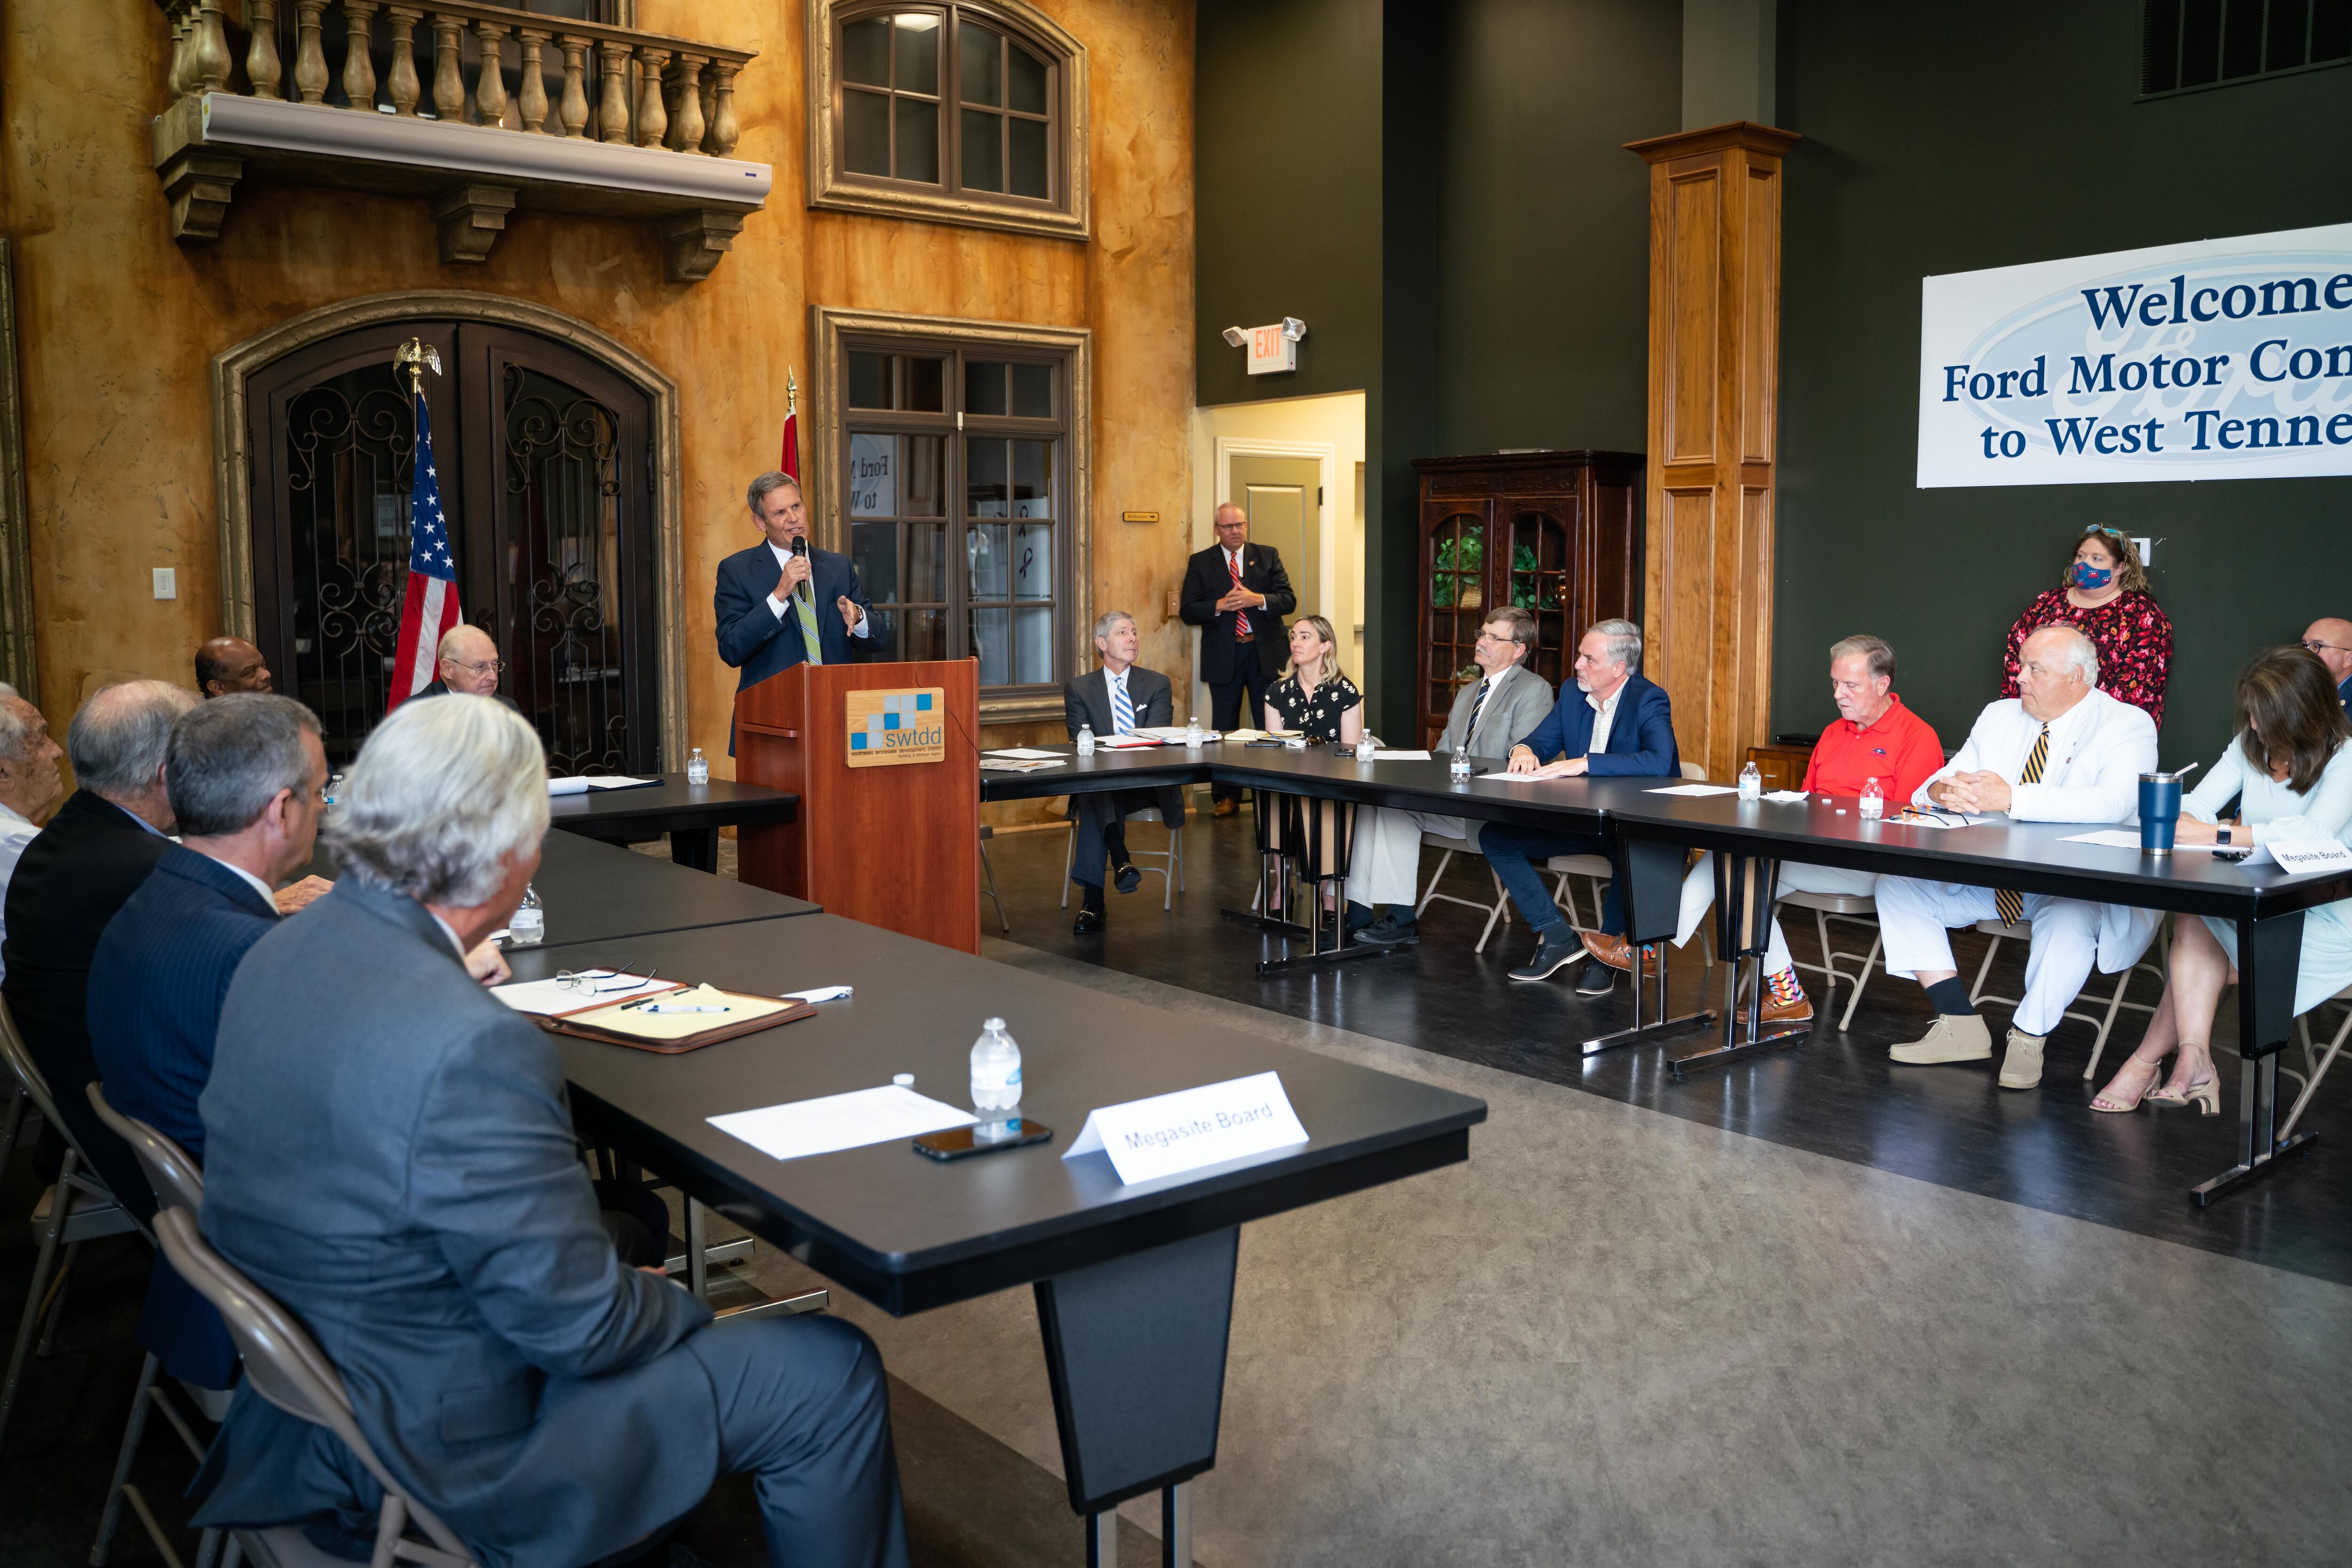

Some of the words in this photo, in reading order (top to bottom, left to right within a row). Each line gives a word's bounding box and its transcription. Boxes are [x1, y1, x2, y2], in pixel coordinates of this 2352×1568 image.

[2081, 274, 2352, 330] Welcome
[1255, 327, 1281, 359] EXIT
[1943, 355, 2048, 401] Ford
[2067, 354, 2229, 394] Motor
[1981, 425, 2026, 459] to
[2044, 417, 2164, 455] West
[2185, 410, 2352, 450] Tenne
[886, 726, 941, 748] swtdd
[2281, 853, 2320, 862] Megasite
[2319, 851, 2347, 859] Board
[1125, 1119, 1213, 1149] Megasite
[1216, 1102, 1272, 1128] Board
